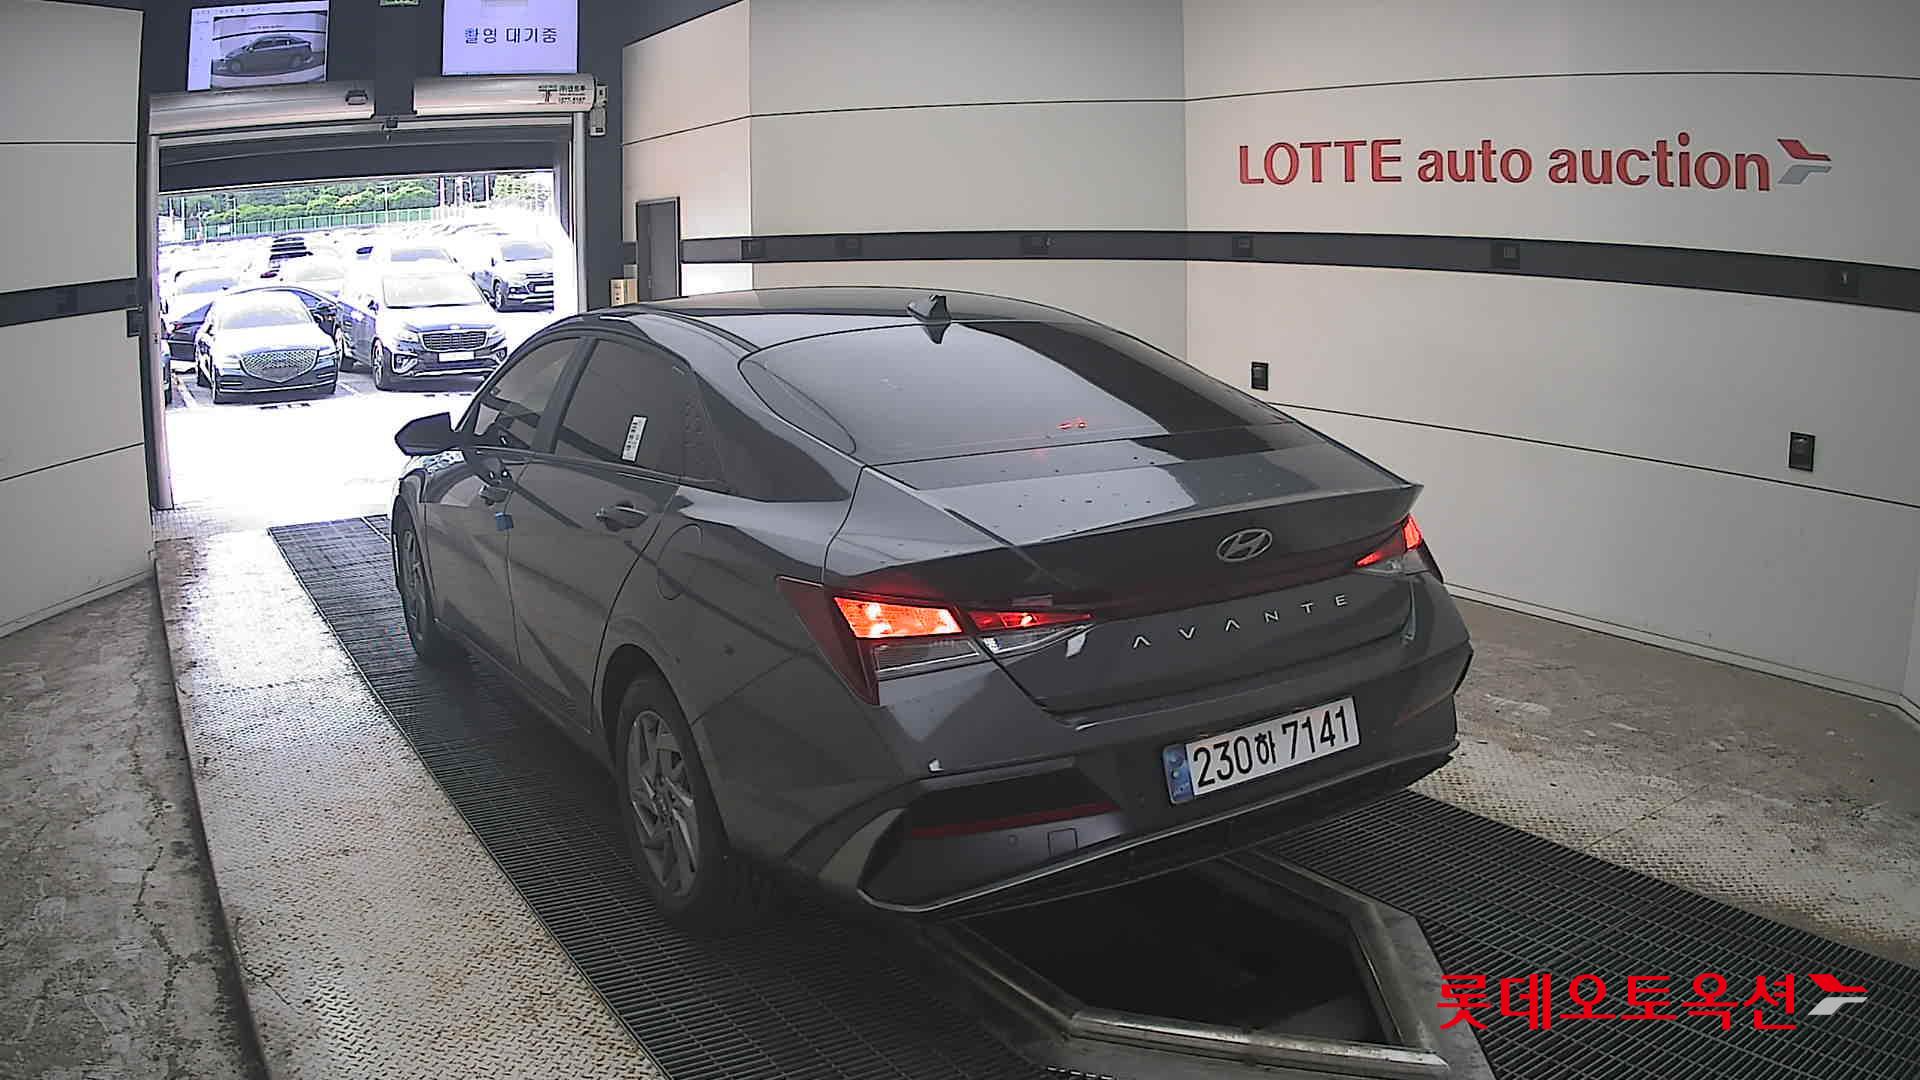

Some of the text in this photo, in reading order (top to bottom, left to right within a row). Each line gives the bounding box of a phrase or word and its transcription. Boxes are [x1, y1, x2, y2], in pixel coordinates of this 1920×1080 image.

[505, 27, 557, 44] 대기중
[1239, 132, 1771, 192] LOTTE auto auction
[1132, 594, 1348, 649] AVANTE
[1192, 705, 1350, 789] 230하 7141
